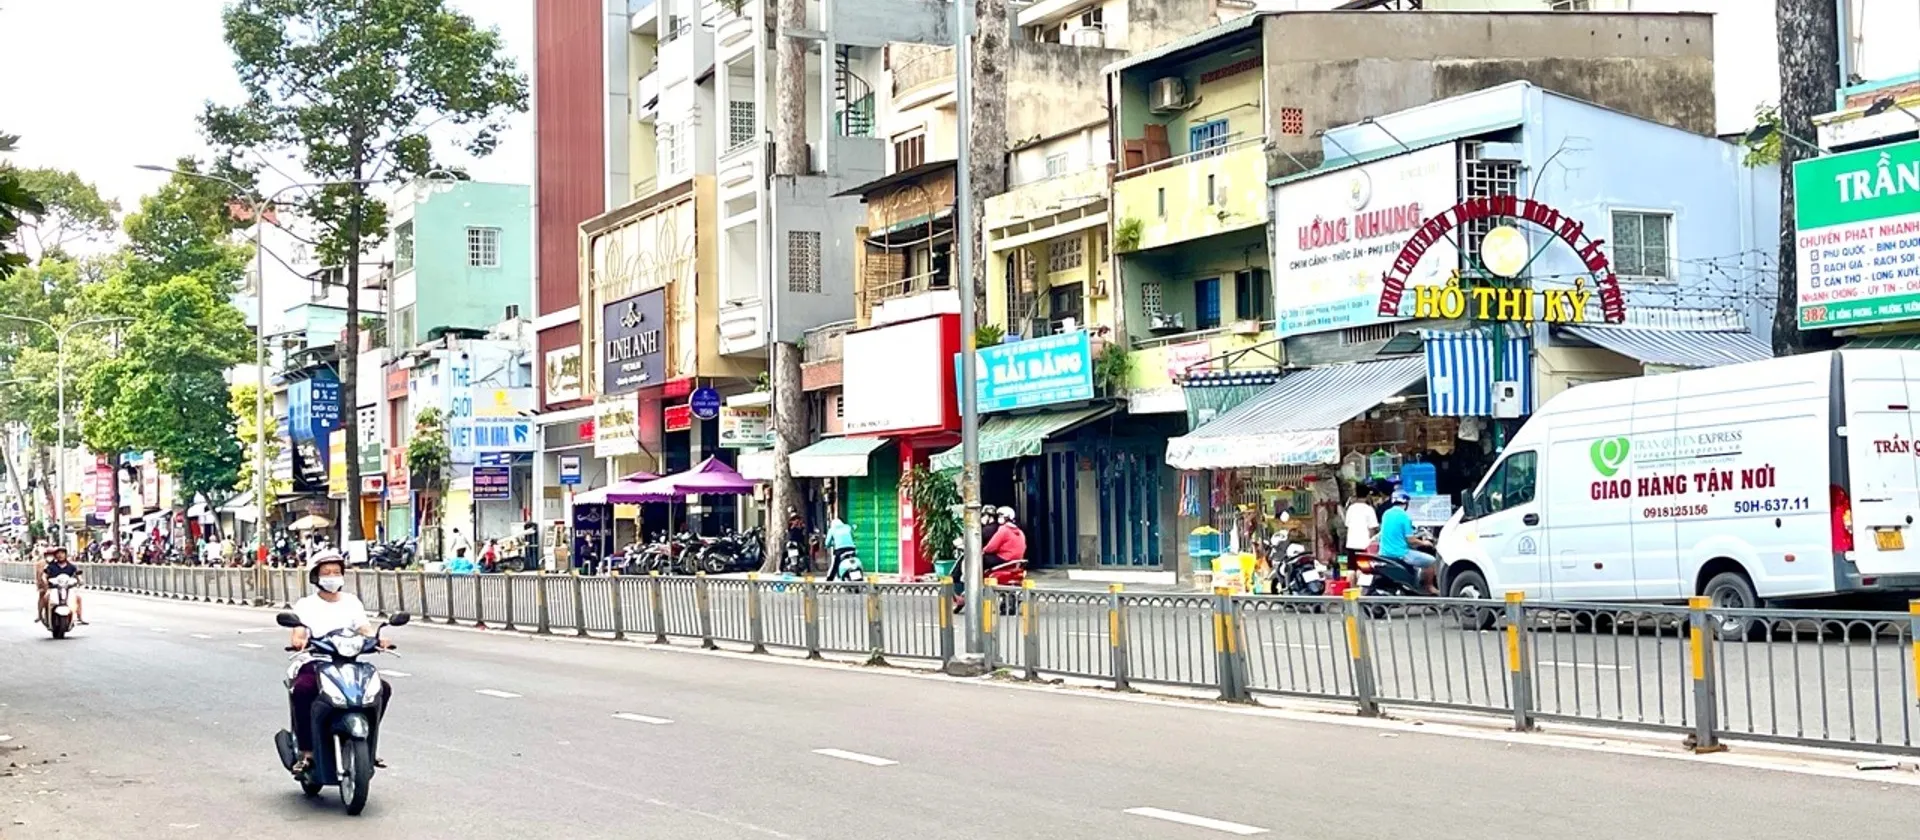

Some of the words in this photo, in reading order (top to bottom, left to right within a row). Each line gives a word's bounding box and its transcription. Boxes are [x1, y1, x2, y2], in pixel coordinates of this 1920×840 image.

[1835, 151, 1920, 203] TRẦN
[1298, 213, 1350, 251] HỒNG
[1355, 202, 1423, 240] NHUNG
[1523, 198, 1560, 229] HOA
[1880, 221, 1920, 237] NHANH
[1415, 268, 1466, 319] HỒ
[1473, 287, 1534, 329] THỊ
[1802, 306, 1828, 323] 382
[607, 336, 632, 363] LINH
[632, 329, 657, 357] ANH
[1698, 430, 1743, 446] EXPRESS
[1591, 479, 1632, 501] GIAO
[1637, 472, 1687, 498] HÀNG
[1694, 467, 1734, 498] TẬN
[1741, 463, 1776, 490] NƠI
[1643, 504, 1709, 519] 0918125156
[1734, 497, 1810, 514] 50H-637.11
